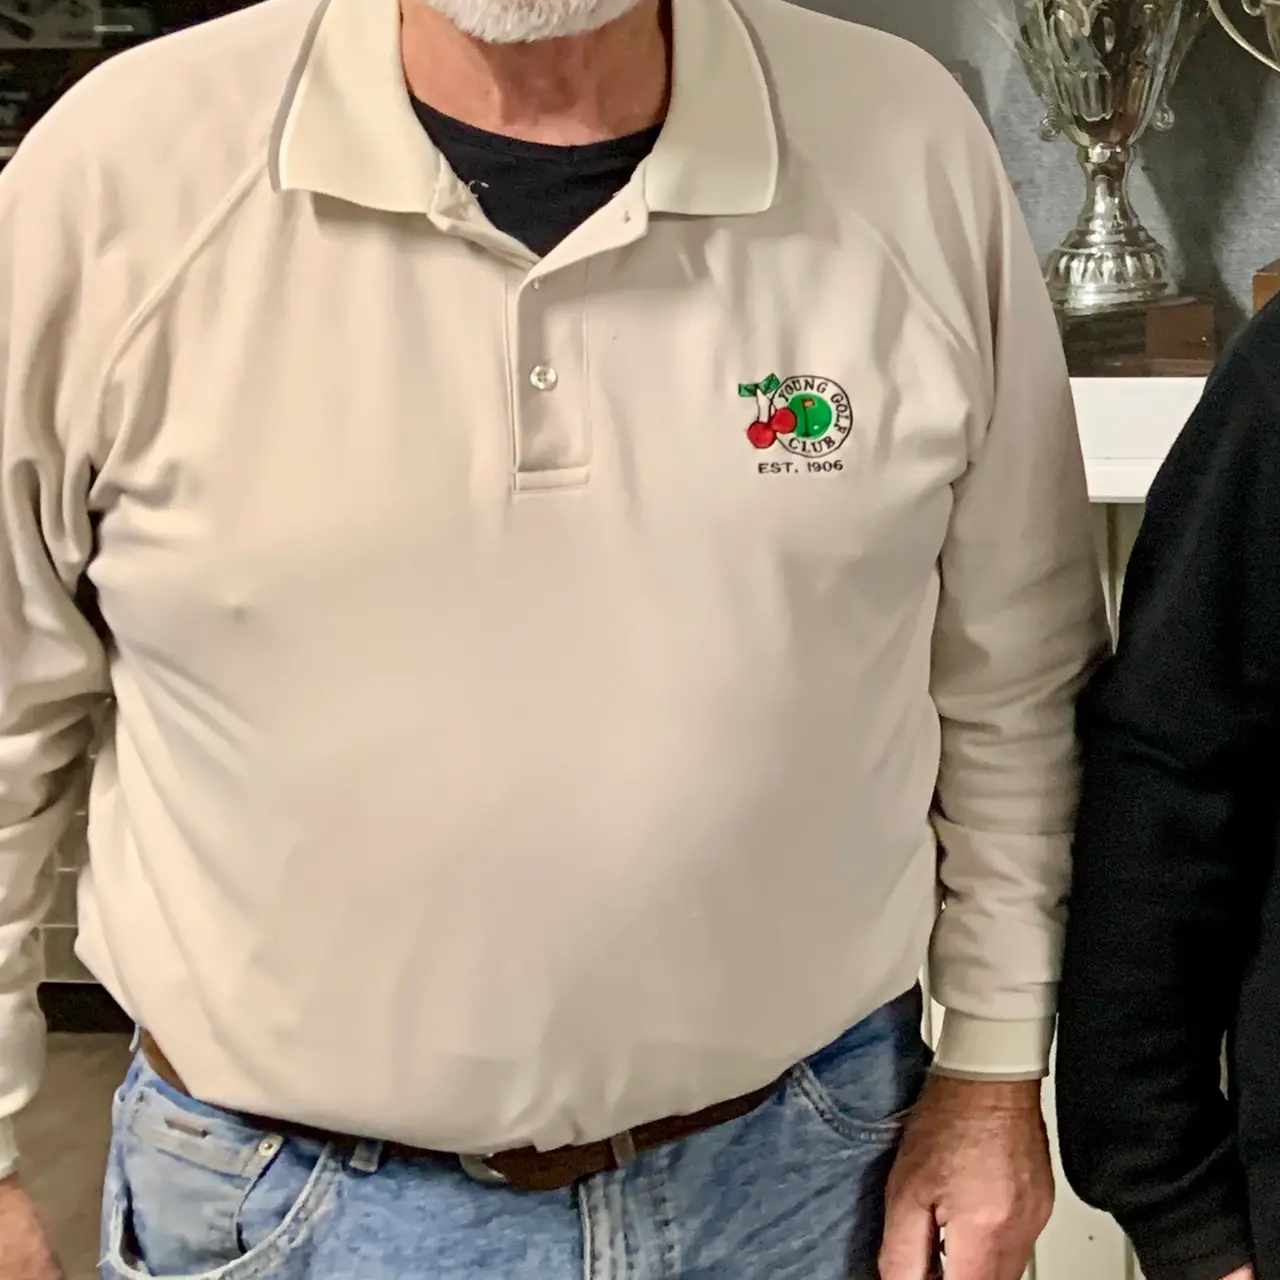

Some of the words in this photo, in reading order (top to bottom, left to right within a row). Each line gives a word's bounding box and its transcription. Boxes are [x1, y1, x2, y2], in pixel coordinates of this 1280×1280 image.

[778, 379, 828, 402] YOUNG
[830, 393, 851, 434] GOLF
[788, 436, 836, 453] CLUB
[758, 462, 798, 473] EST.
[807, 460, 844, 472] 1906
